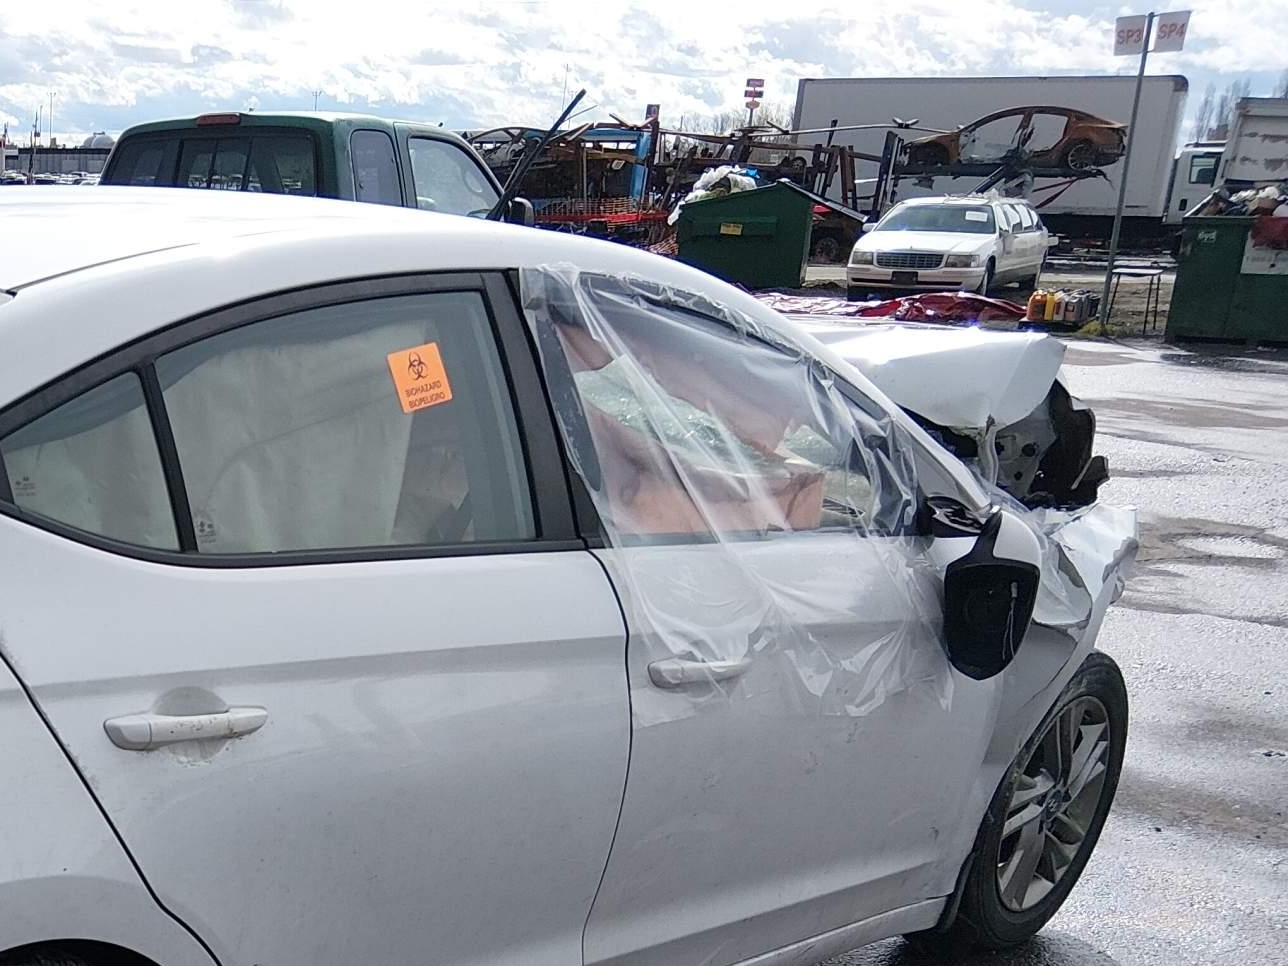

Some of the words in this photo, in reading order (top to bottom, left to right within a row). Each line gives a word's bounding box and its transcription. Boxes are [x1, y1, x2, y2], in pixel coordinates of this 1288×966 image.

[1116, 28, 1144, 45] SP3
[1157, 22, 1187, 41] SP4
[405, 380, 442, 398] BIOHAZARD
[408, 391, 446, 409] BIOPELIGRO
